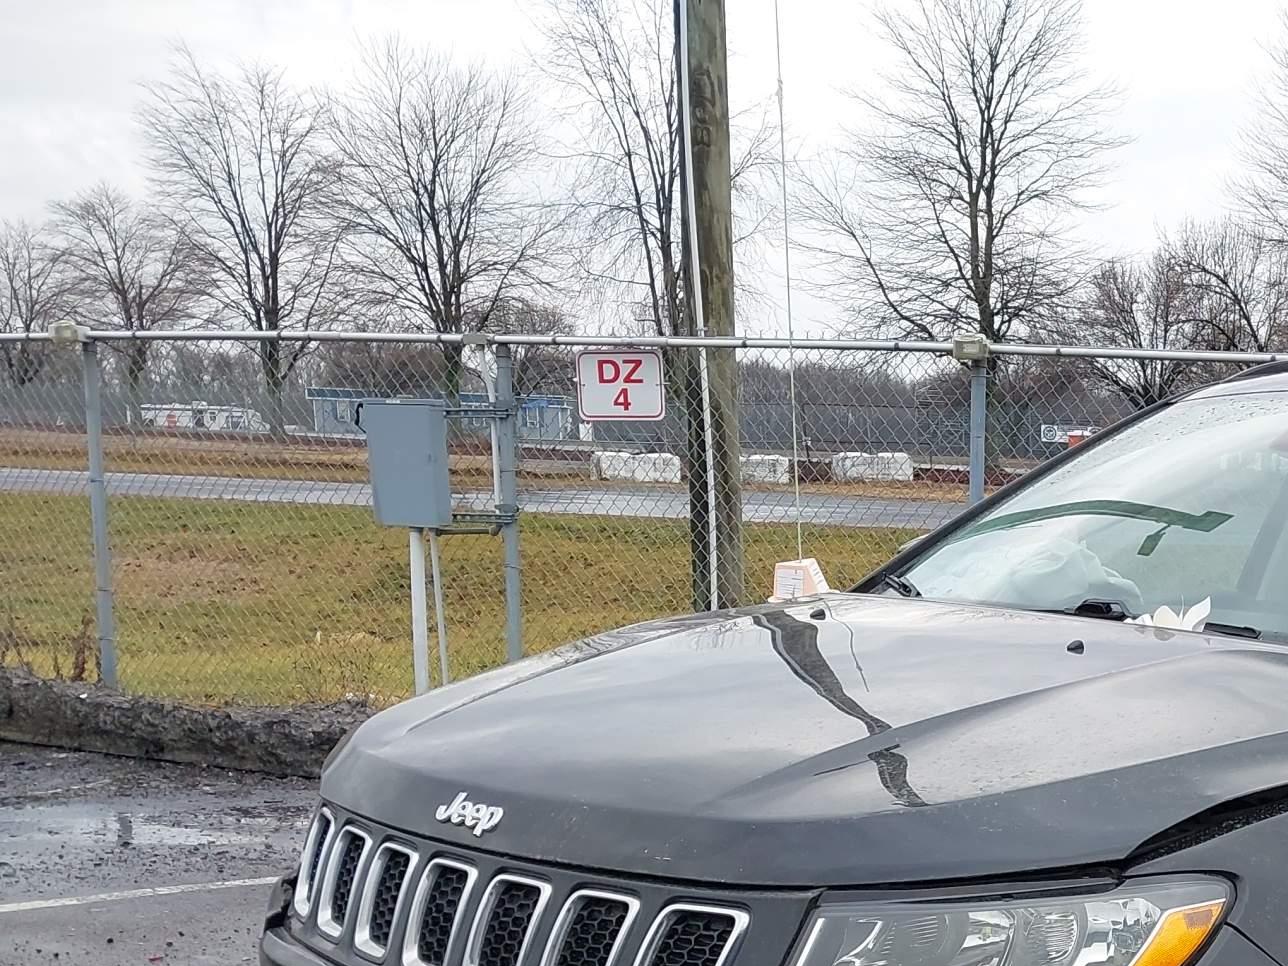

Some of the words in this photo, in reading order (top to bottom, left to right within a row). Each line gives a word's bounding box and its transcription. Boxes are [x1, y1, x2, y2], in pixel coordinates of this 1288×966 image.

[597, 359, 644, 384] DZ
[613, 388, 632, 411] 4
[435, 791, 504, 838] Jeep
